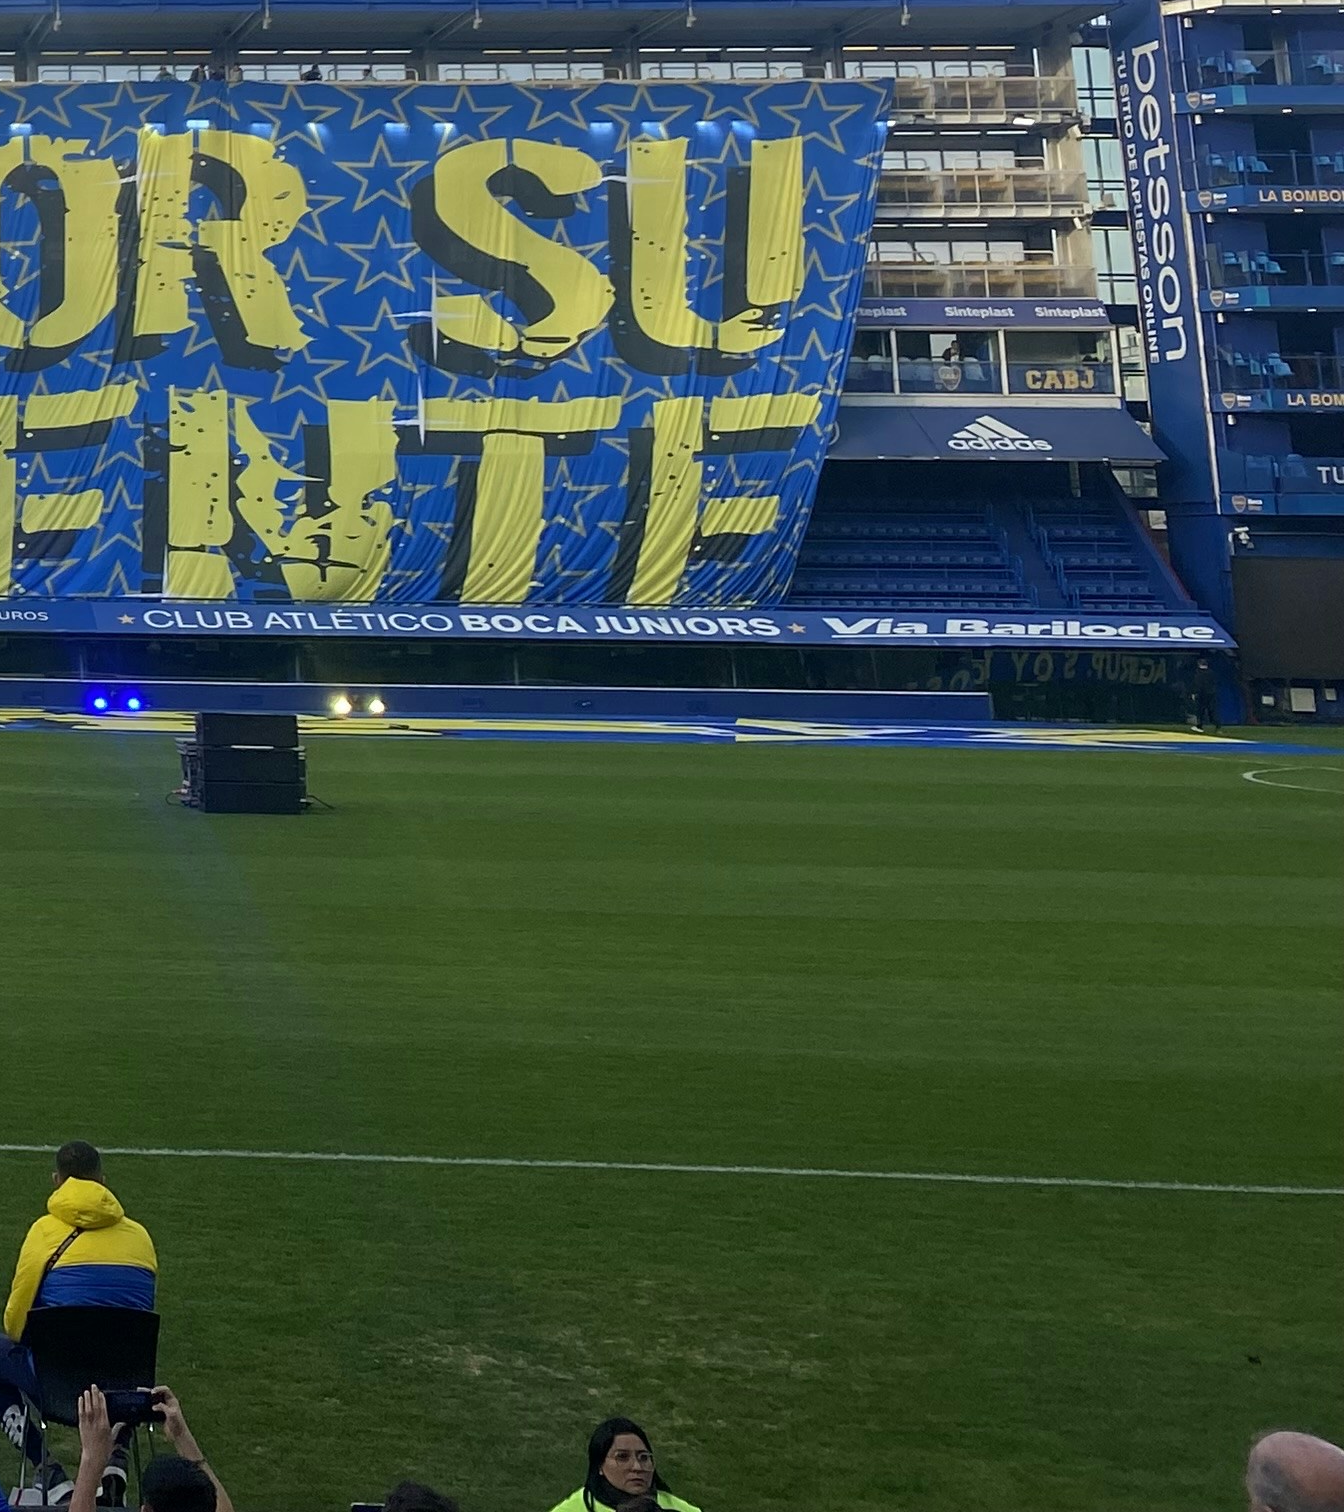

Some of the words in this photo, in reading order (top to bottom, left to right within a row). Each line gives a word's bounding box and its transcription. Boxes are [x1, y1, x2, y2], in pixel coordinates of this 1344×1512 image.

[1132, 40, 1187, 362] betsson
[1259, 190, 1278, 202] LA
[435, 136, 806, 356] SU
[1130, 176, 1150, 280] APUESTAS
[1143, 285, 1160, 364] ONLINE
[944, 306, 1015, 319] Sinteplast
[1034, 306, 1107, 319] Sinteplast
[1025, 369, 1095, 390] CABJ
[1286, 393, 1306, 406] LA
[948, 436, 1054, 451] adidas
[143, 609, 253, 630] CLUB
[264, 608, 453, 632] ATLÉTICO
[459, 614, 588, 634] BOCA
[595, 615, 781, 637] JUNIORS
[946, 619, 1215, 639] Bariloche
